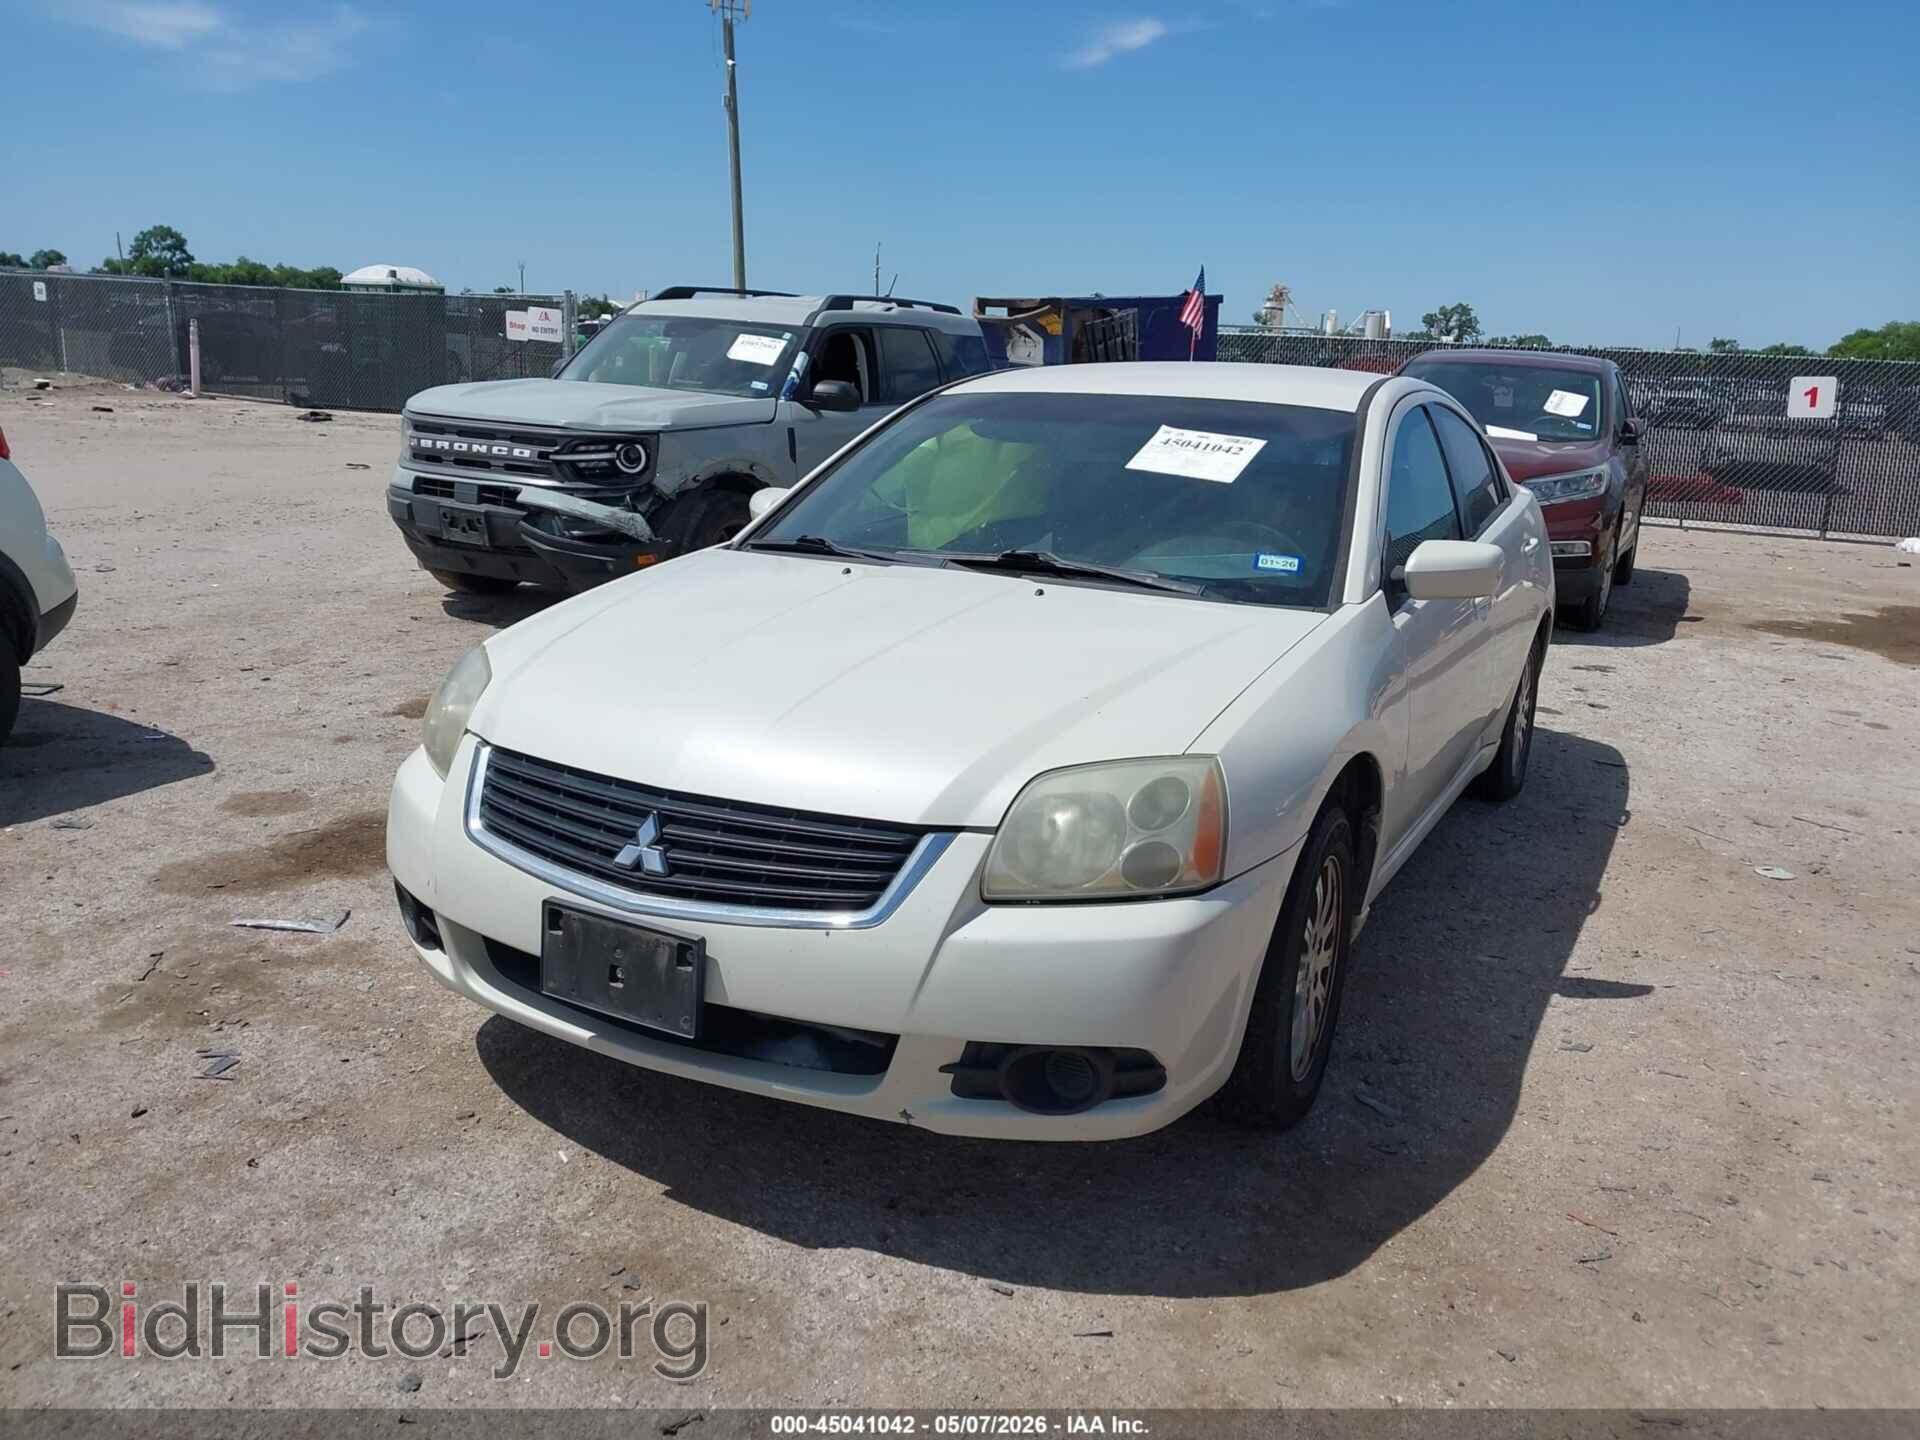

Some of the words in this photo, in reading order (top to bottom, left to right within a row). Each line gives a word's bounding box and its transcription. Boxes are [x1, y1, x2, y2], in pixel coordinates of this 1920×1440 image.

[1804, 386, 1819, 408] 1
[420, 438, 531, 458] BRONCO
[1160, 437, 1244, 456] 45041042
